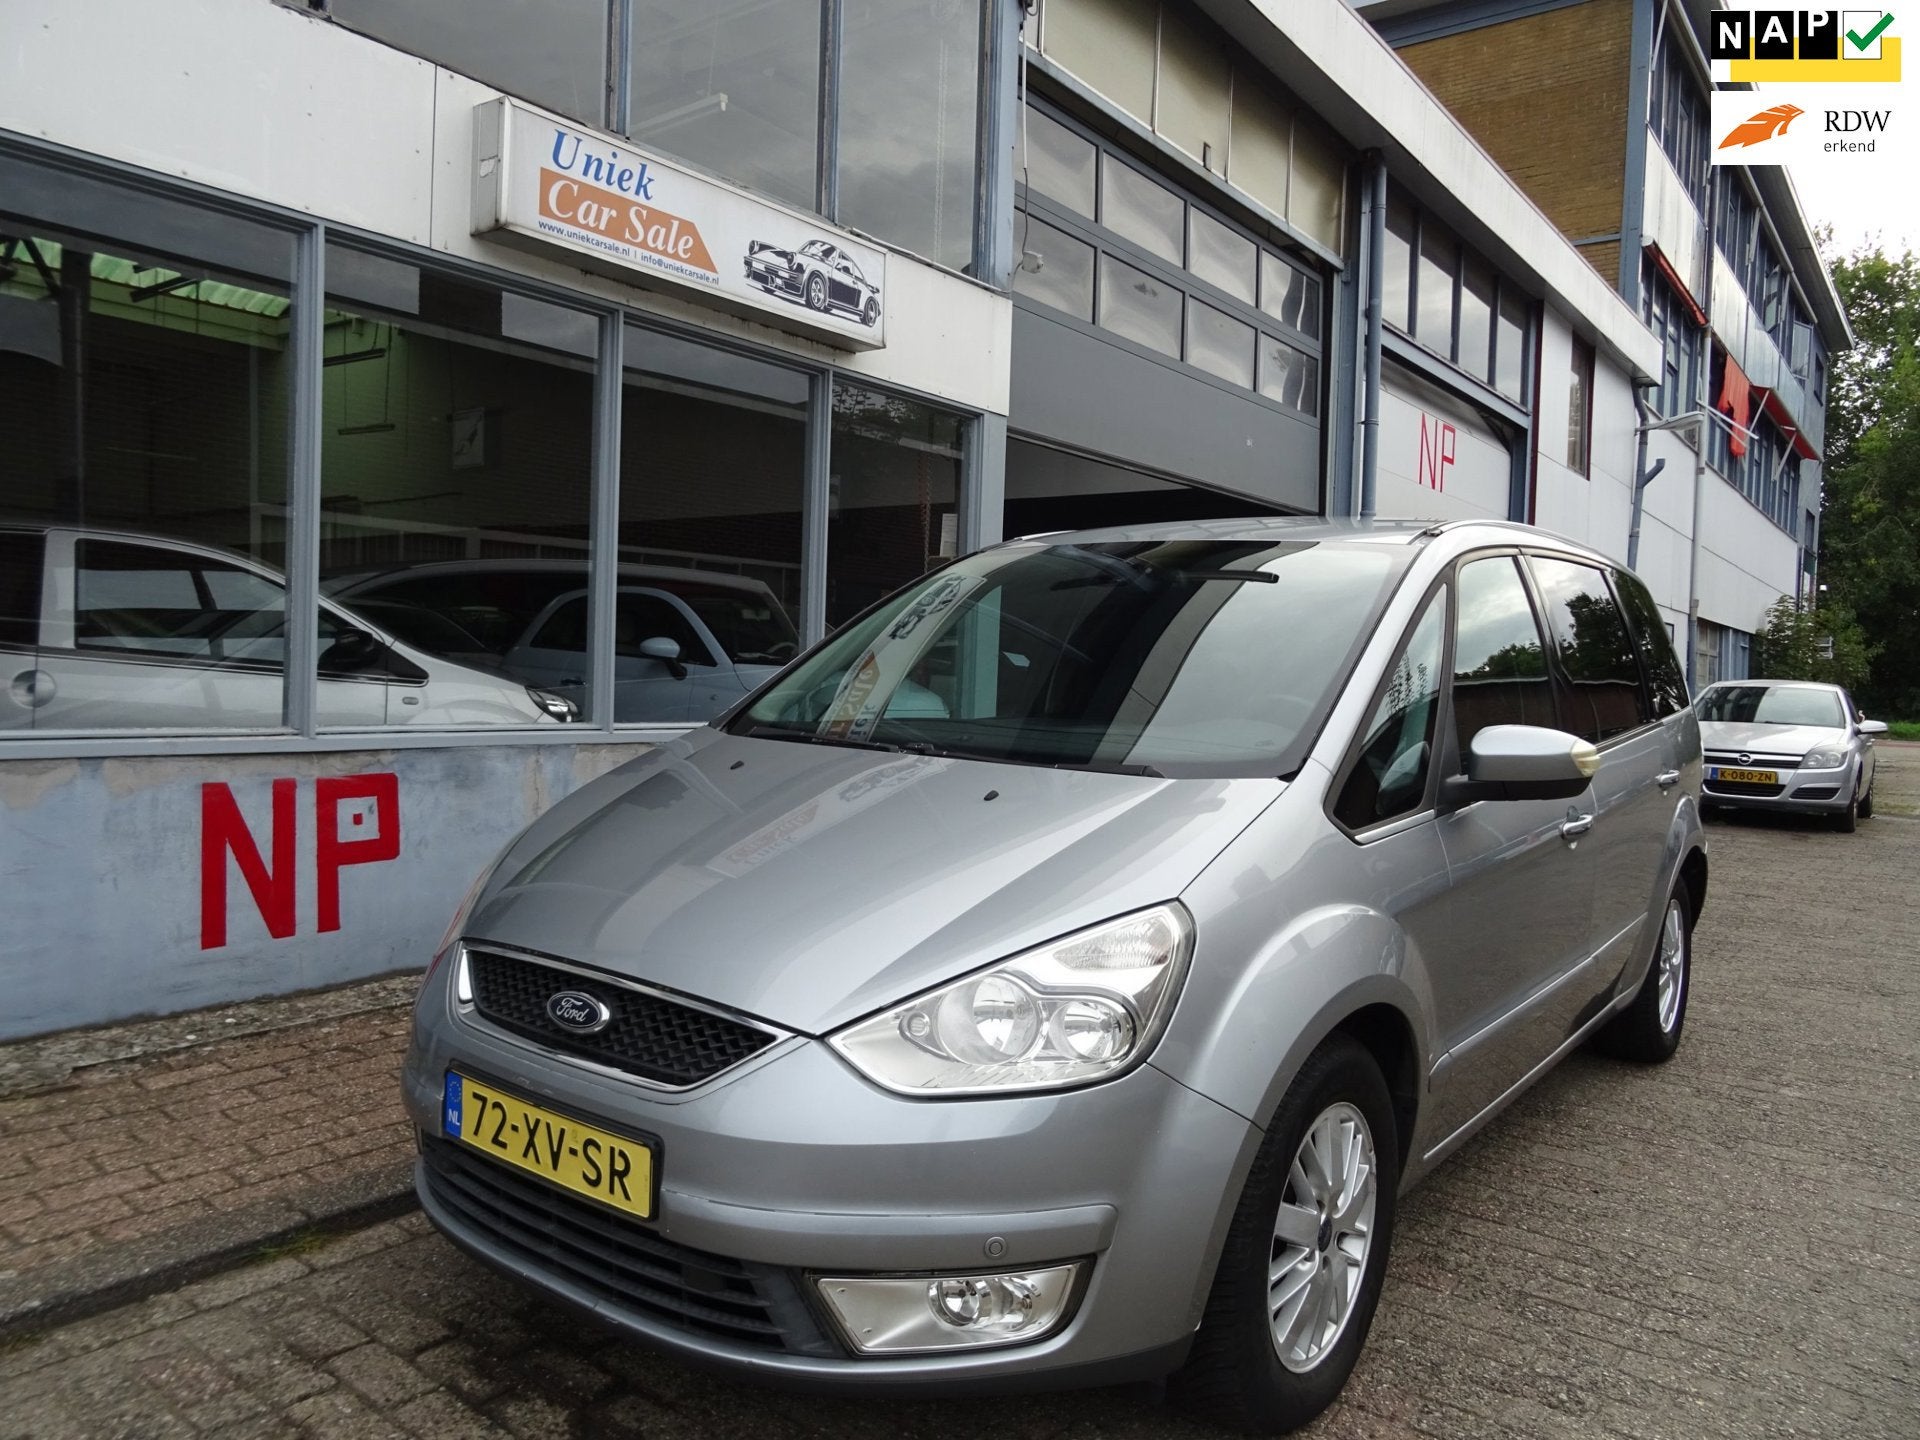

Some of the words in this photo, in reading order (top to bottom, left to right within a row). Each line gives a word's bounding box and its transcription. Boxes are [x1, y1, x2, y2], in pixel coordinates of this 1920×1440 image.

[551, 129, 656, 200] Uniek
[538, 219, 630, 257] www.uniekcarsale.nl
[640, 254, 720, 286] info@uniekcarsale.nl
[548, 180, 617, 231] Car
[624, 206, 694, 259] Sale
[1418, 412, 1456, 493] NP
[1720, 770, 1772, 782] K-080-ZN
[201, 772, 400, 950] NP
[556, 997, 589, 1022] Ford
[448, 1107, 460, 1126] NL
[471, 1091, 632, 1202] 72-XV-SR
